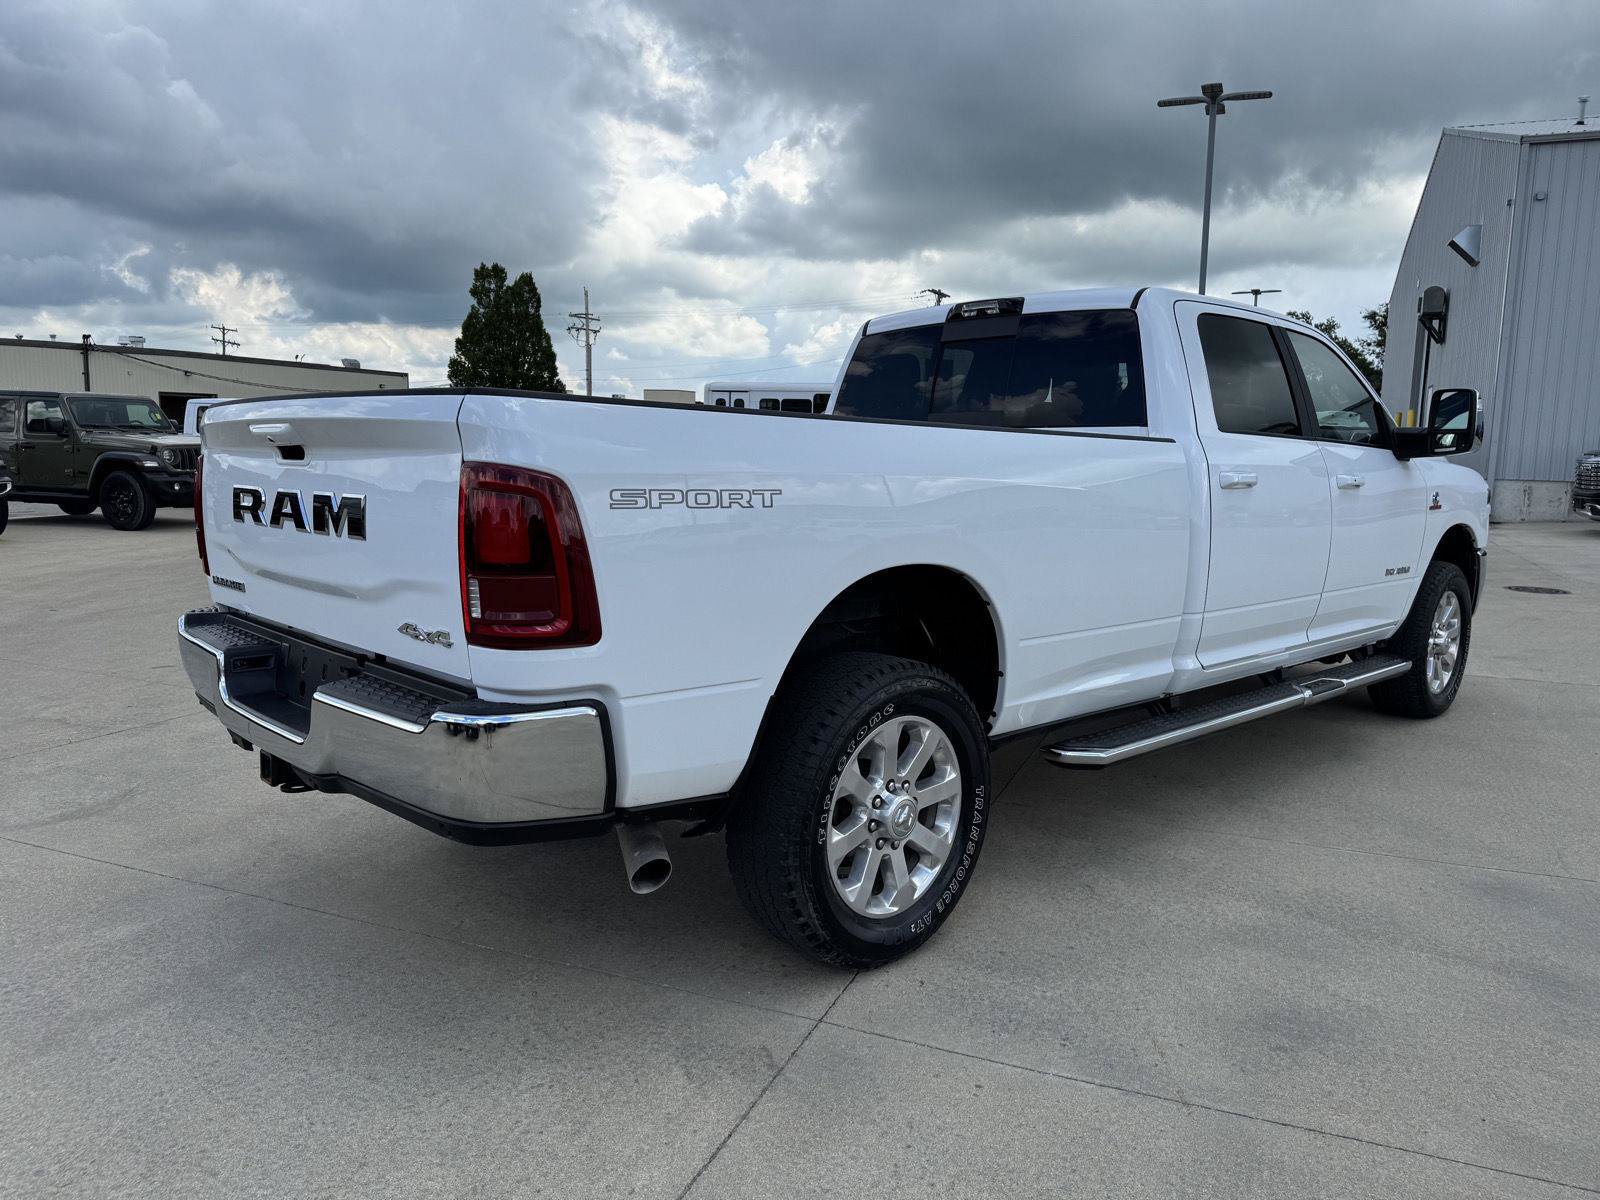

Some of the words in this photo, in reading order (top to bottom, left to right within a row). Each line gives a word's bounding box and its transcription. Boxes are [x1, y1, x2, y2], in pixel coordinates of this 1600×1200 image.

[232, 484, 366, 541] RAM
[609, 489, 782, 509] SPORT
[936, 785, 985, 914] TRANSFORCE
